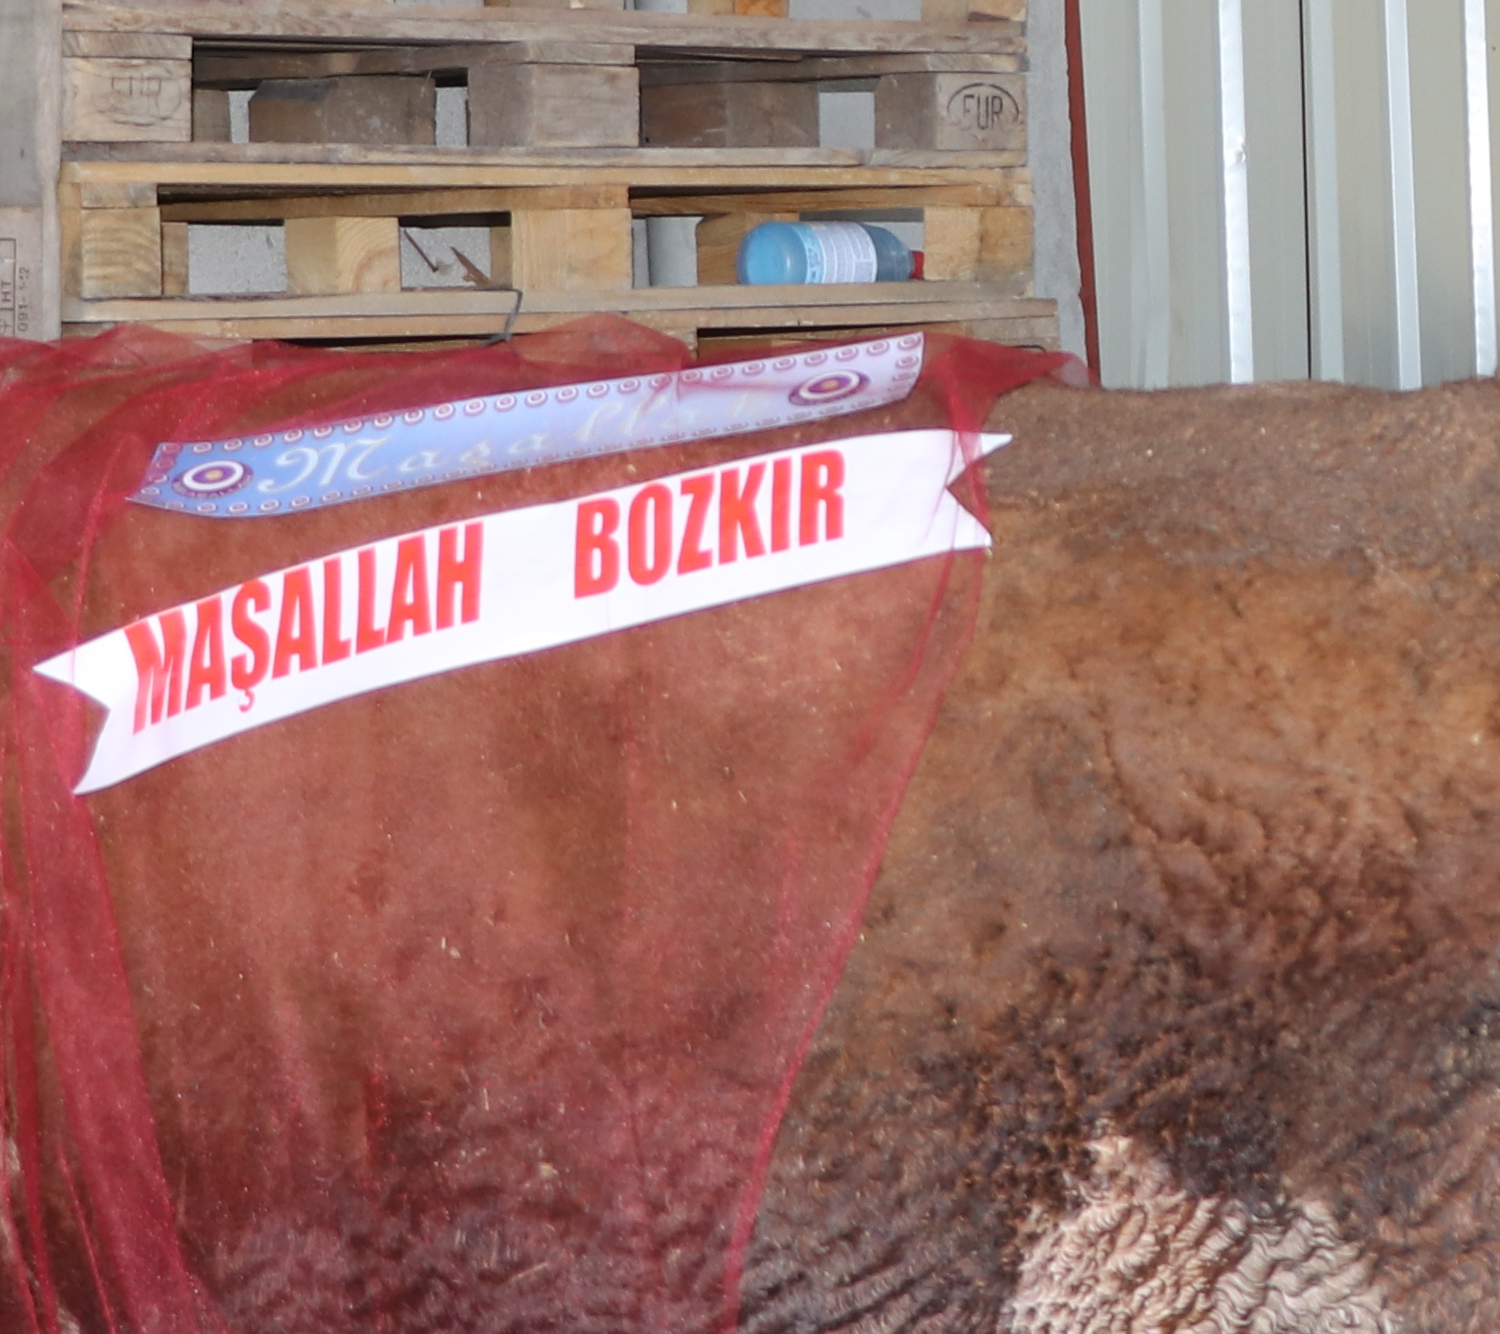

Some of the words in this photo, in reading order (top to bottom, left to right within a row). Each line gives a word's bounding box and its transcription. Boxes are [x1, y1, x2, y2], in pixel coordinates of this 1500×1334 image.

[1, 279, 12, 303] HT
[124, 522, 483, 732] MAŞALLAH
[574, 449, 845, 598] BOZKIR
